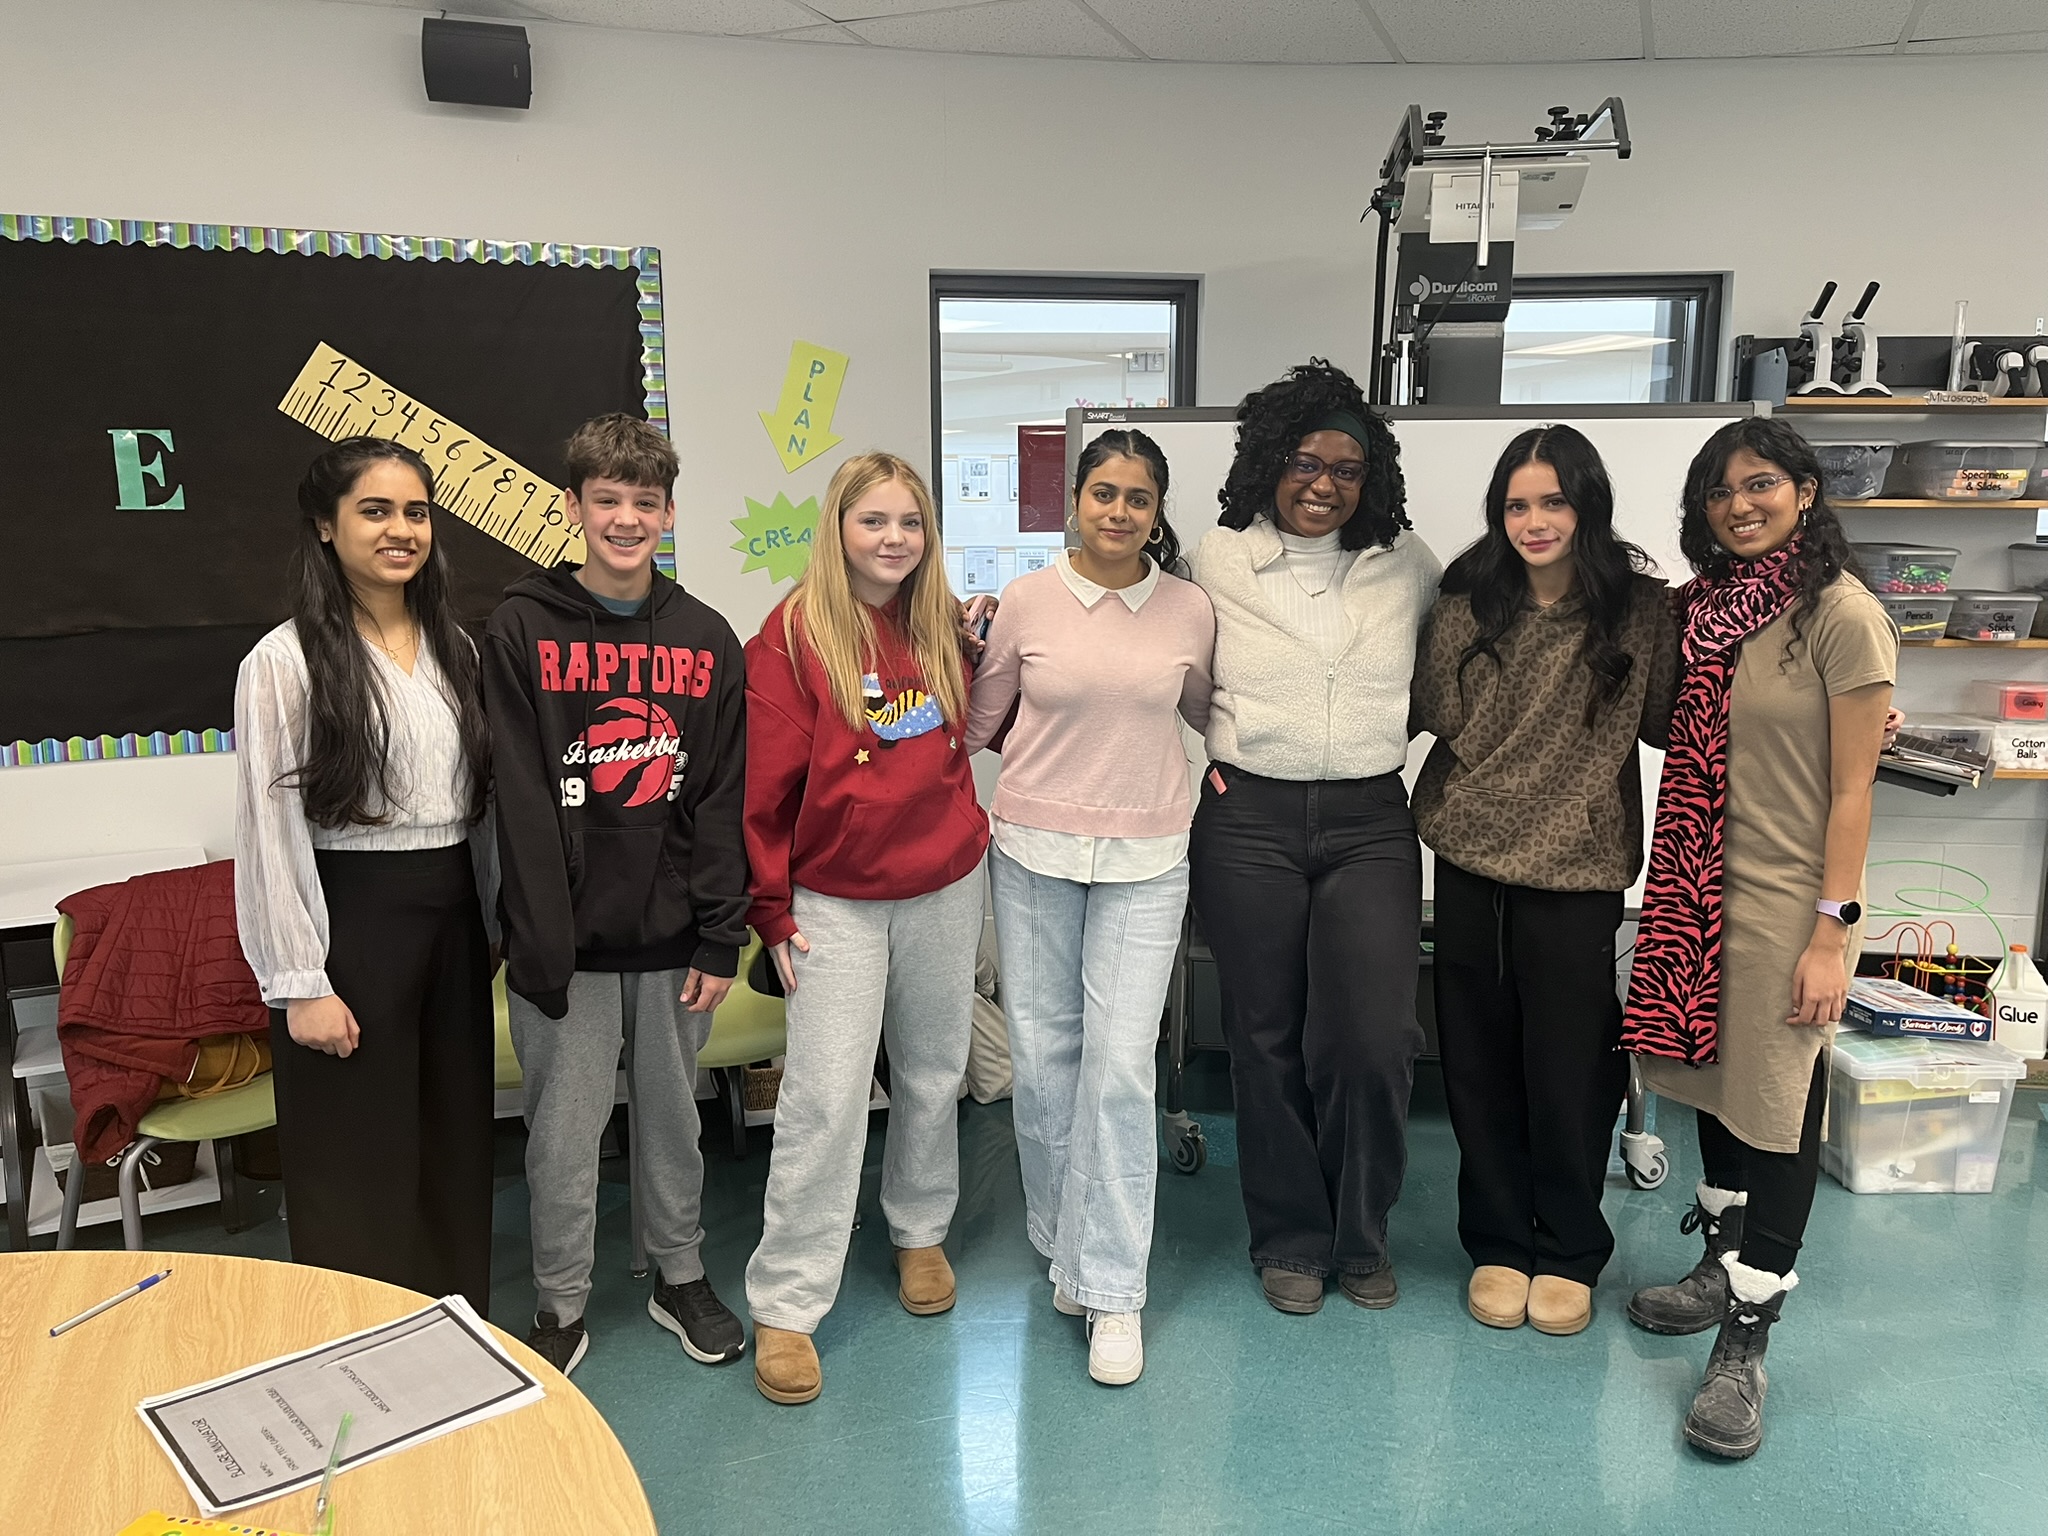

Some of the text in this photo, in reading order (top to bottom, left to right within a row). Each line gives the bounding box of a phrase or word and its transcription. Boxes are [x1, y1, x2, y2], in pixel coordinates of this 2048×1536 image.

[1455, 202, 1495, 210] HITAI
[1929, 392, 1989, 403] Microscopes
[786, 358, 826, 457] PLAN
[1087, 411, 1110, 420] SMART
[319, 359, 347, 389] 1
[342, 372, 371, 403] 2
[371, 388, 397, 417] 3
[400, 400, 420, 434] 4
[422, 417, 448, 444] 5
[445, 438, 471, 461] 6
[471, 450, 498, 473] 7
[493, 467, 518, 494] 8
[522, 481, 539, 508] 9
[538, 493, 564, 526] 10
[106, 428, 186, 511] E
[1961, 470, 2010, 481] Specimens
[1976, 482, 2002, 491] Slides
[748, 526, 813, 557] CREA
[1905, 610, 1934, 620] Pencils
[1992, 612, 2015, 623] Glue
[1987, 622, 2016, 633] Sticks
[537, 639, 715, 699] RAPTORS
[562, 731, 684, 766] Basketba
[2011, 738, 2046, 749] Cotton
[2016, 749, 2038, 759] Balls
[1998, 1006, 2039, 1024] Glue
[191, 1418, 245, 1479] FUTURE INNOVATOR
